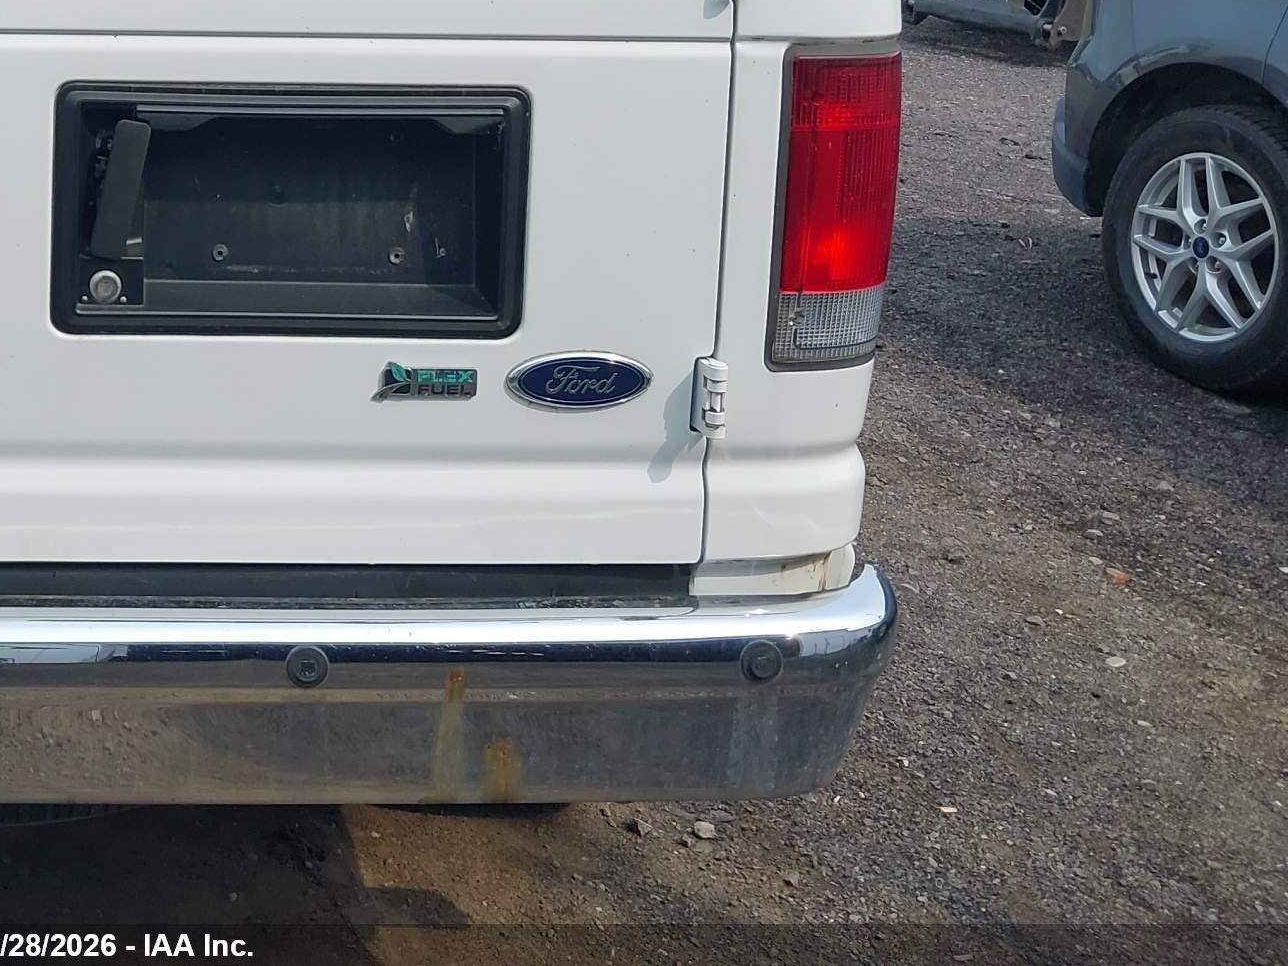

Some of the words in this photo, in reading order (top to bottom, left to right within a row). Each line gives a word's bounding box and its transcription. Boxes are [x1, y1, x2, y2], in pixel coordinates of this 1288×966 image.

[417, 369, 475, 383] FLEX
[544, 365, 617, 395] Ford
[417, 384, 473, 396] FUEL
